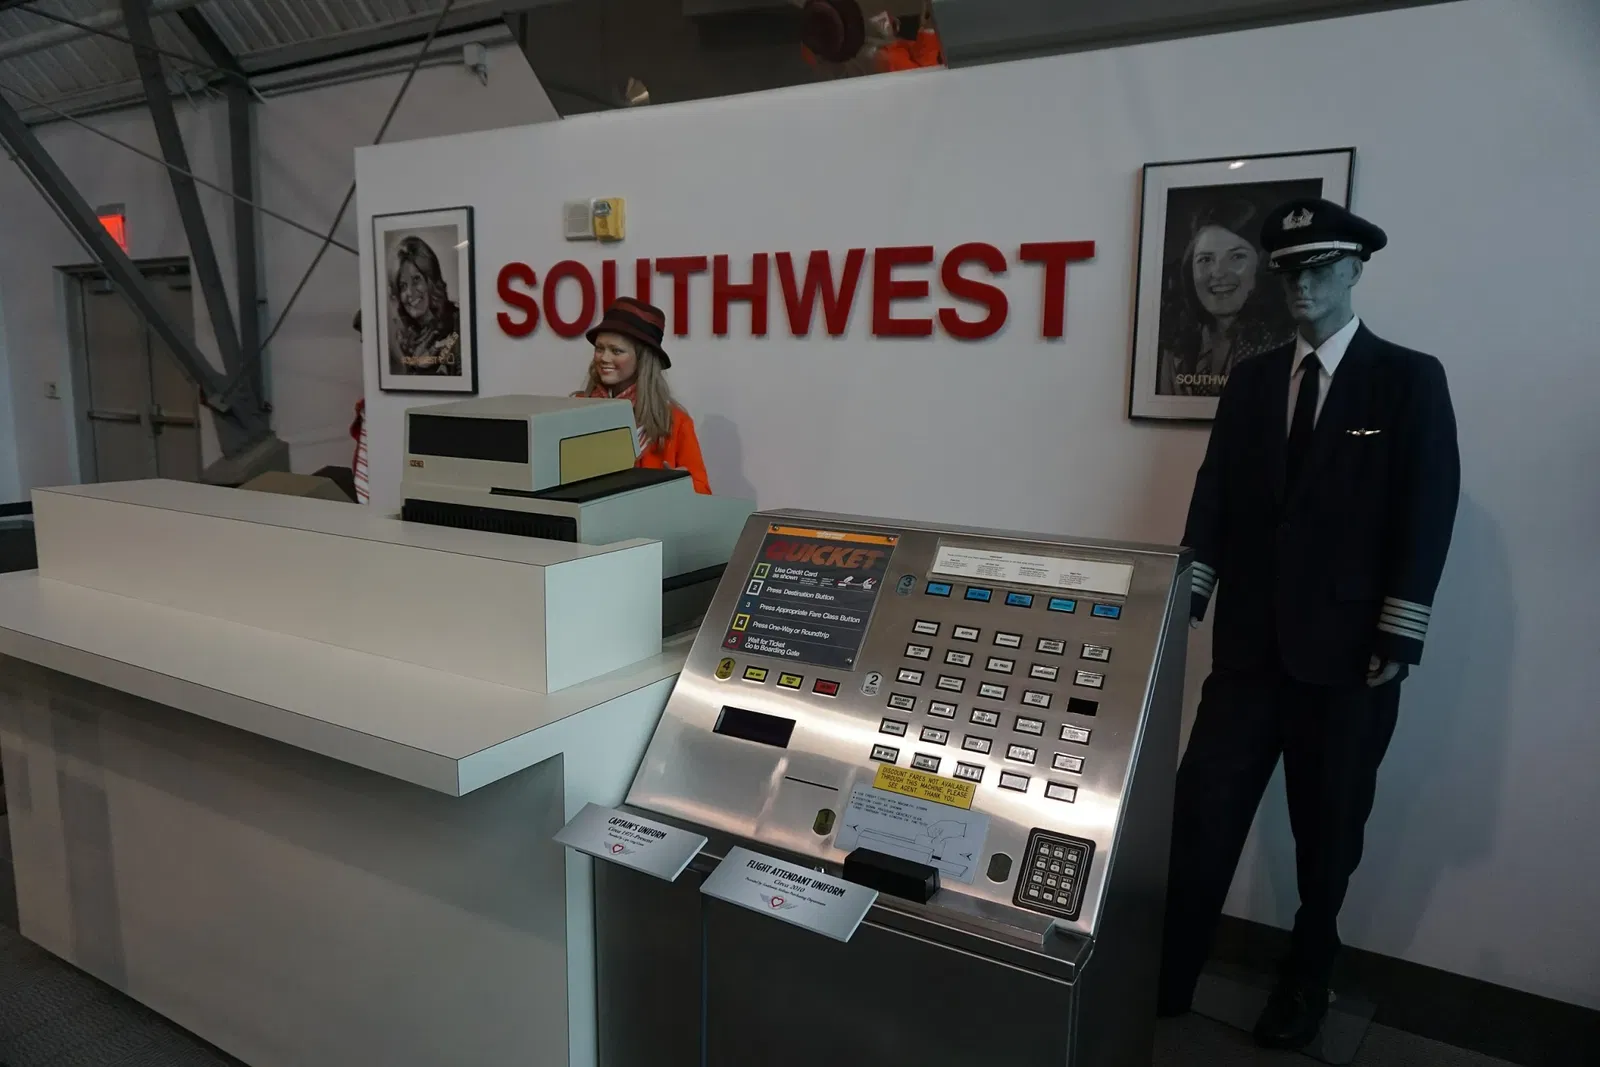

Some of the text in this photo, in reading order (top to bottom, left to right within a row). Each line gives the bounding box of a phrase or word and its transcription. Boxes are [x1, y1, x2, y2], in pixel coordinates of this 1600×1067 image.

[496, 240, 1096, 340] SOUTHWEST
[1175, 373, 1229, 387] SOUTHW
[766, 540, 885, 569] QUICKET
[786, 568, 803, 576] Credit
[904, 577, 912, 587] 3
[766, 586, 782, 594] Press
[784, 588, 814, 599] Destination
[815, 592, 834, 601] Button
[759, 603, 776, 612] Press
[776, 606, 808, 617] Appropriate
[808, 610, 822, 619] Fare
[822, 612, 839, 621] Class
[840, 614, 860, 624] Button
[752, 622, 768, 630] Press
[768, 624, 794, 634] One-Way
[801, 628, 830, 640] Roundtrip
[760, 645, 786, 656] Boarding
[786, 649, 800, 657] Gate
[769, 640, 785, 648] Ticket
[723, 660, 731, 670] 4
[869, 675, 878, 685] 2
[881, 773, 904, 785] THROUGH
[906, 779, 918, 787] THIS
[946, 788, 969, 798] PLEASE
[882, 767, 970, 792] DISCOUNT FARES NOT AVAILABLE
[924, 790, 942, 800] THANK
[608, 816, 640, 831] CAPTAIN'S
[638, 825, 668, 840] UNIFORM
[746, 860, 847, 898] FLIGHT ATTENDANT UNIFORM
[773, 879, 806, 893] Circa 2010
